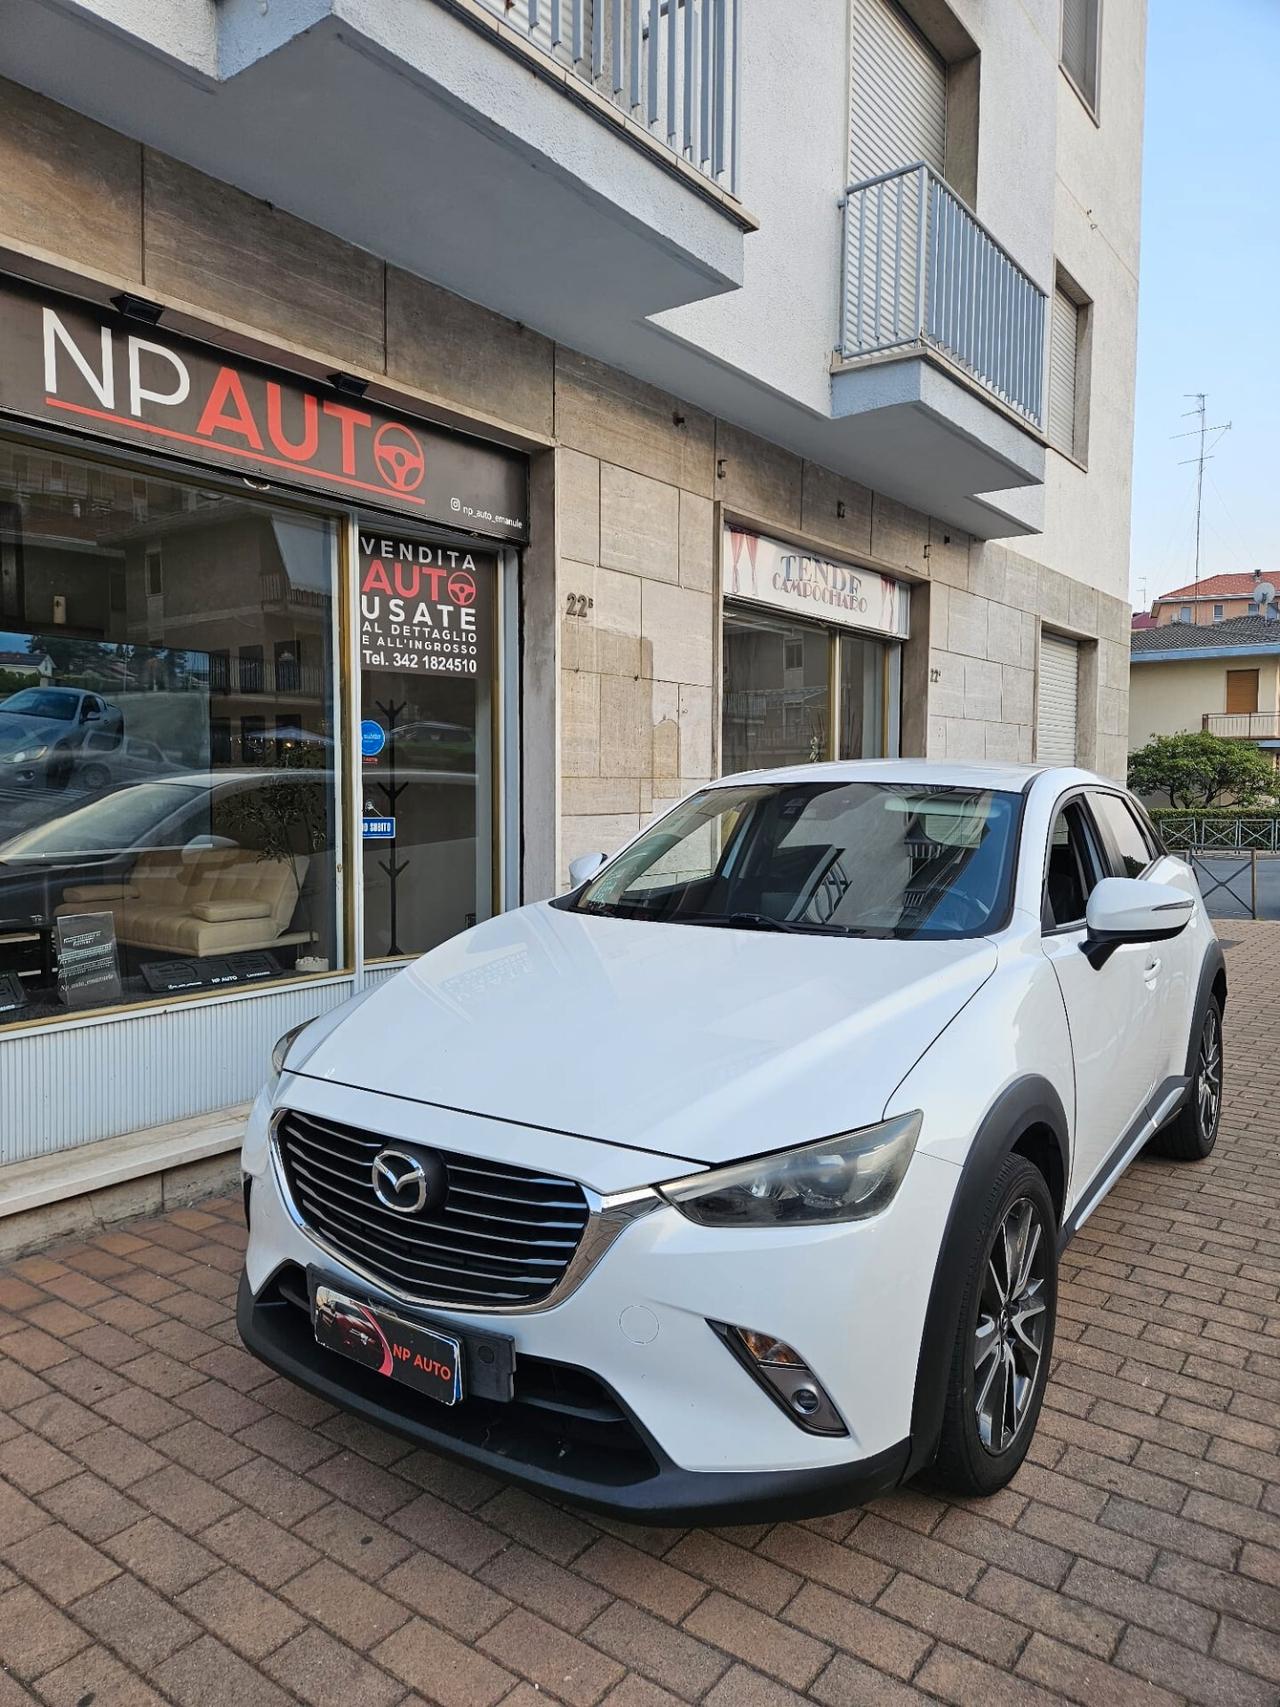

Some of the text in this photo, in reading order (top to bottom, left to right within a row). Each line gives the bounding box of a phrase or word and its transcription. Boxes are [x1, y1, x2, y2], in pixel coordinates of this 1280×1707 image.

[42, 307, 190, 417] NP
[360, 536, 476, 571] VENDITA
[361, 595, 477, 631] USATE
[362, 621, 477, 643] AL DETTAGLIO
[362, 635, 477, 655] E ALL'INGROSSO
[362, 650, 477, 673] Tel. 342 1824510
[393, 1343, 451, 1381] NP AUTO
